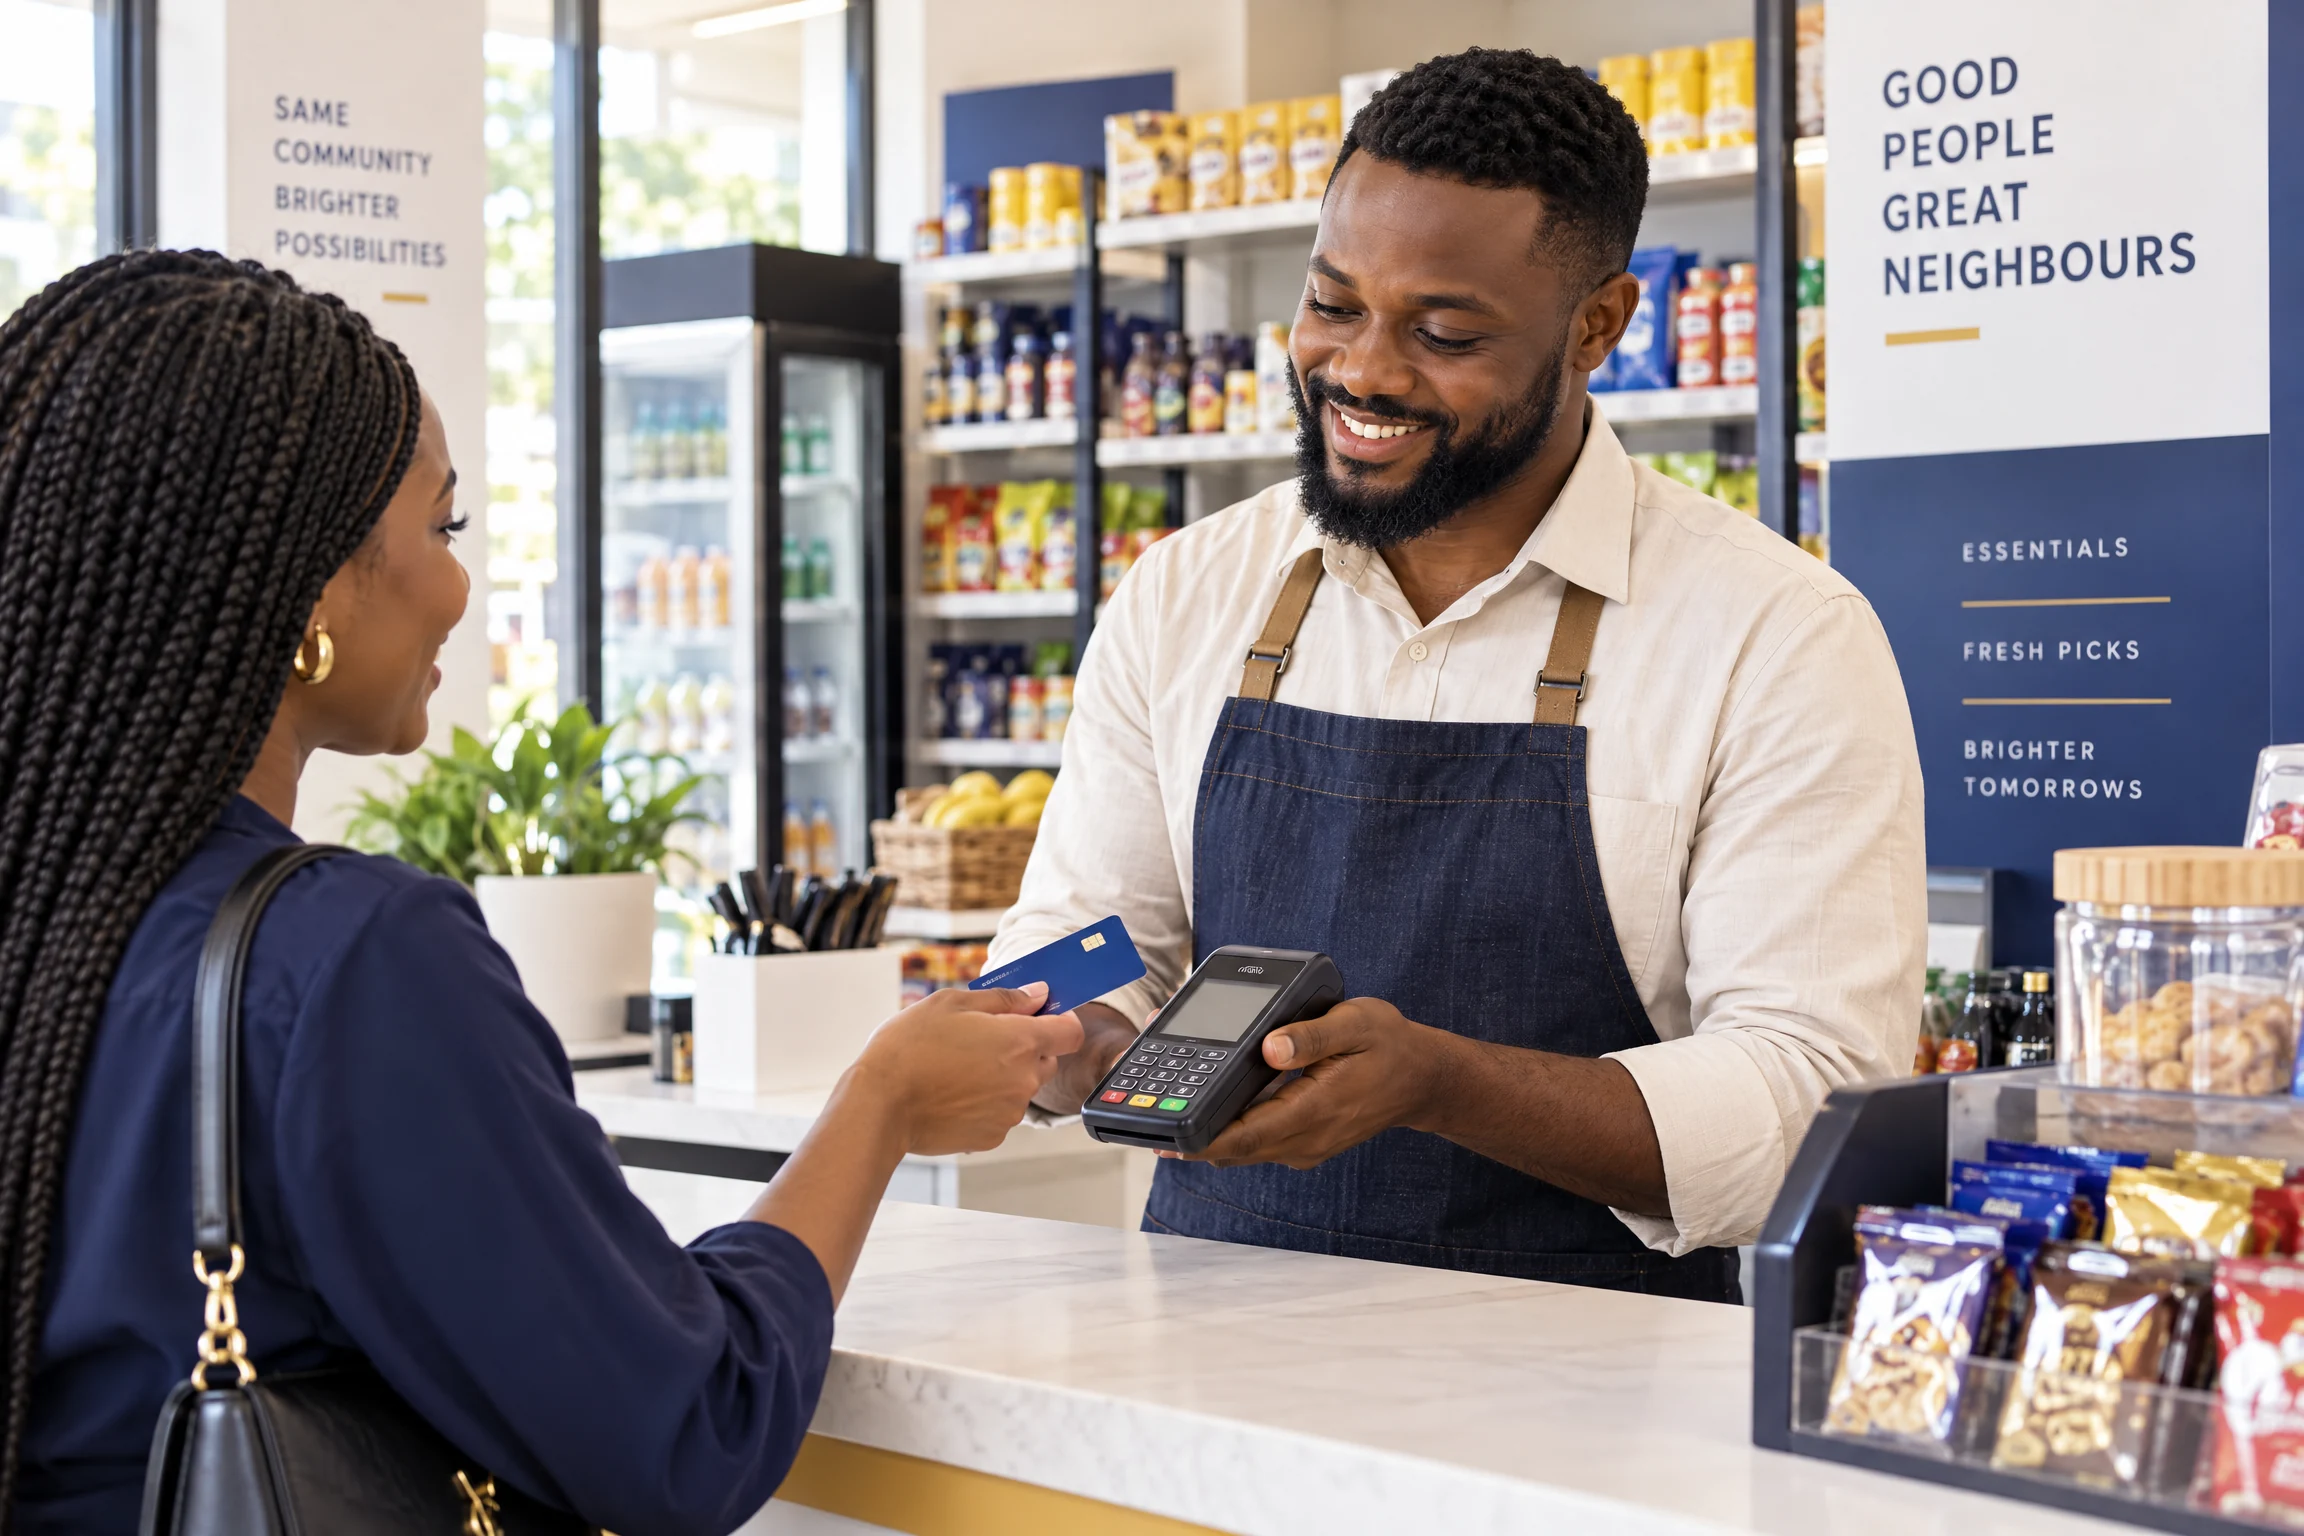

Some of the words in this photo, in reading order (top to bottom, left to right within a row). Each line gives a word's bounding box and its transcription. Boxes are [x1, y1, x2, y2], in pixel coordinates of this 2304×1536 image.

[1883, 56, 2018, 109] GOOD
[275, 95, 348, 127] SAME
[274, 138, 431, 176] COMMUNITY
[1884, 113, 2054, 171] PEOPLE
[275, 185, 400, 219] BRIGHTER
[1883, 181, 2028, 232] GREAT
[275, 229, 447, 268] POSSIBILITIES
[1884, 232, 2196, 295] NEIGHBOURS
[1963, 537, 2128, 562] ESSENTIALS
[1964, 641, 2043, 661] FRESH
[2059, 640, 2140, 660] PICKS
[1964, 740, 2095, 760] BRIGHTER
[1964, 777, 2143, 799] TOMORROWS
